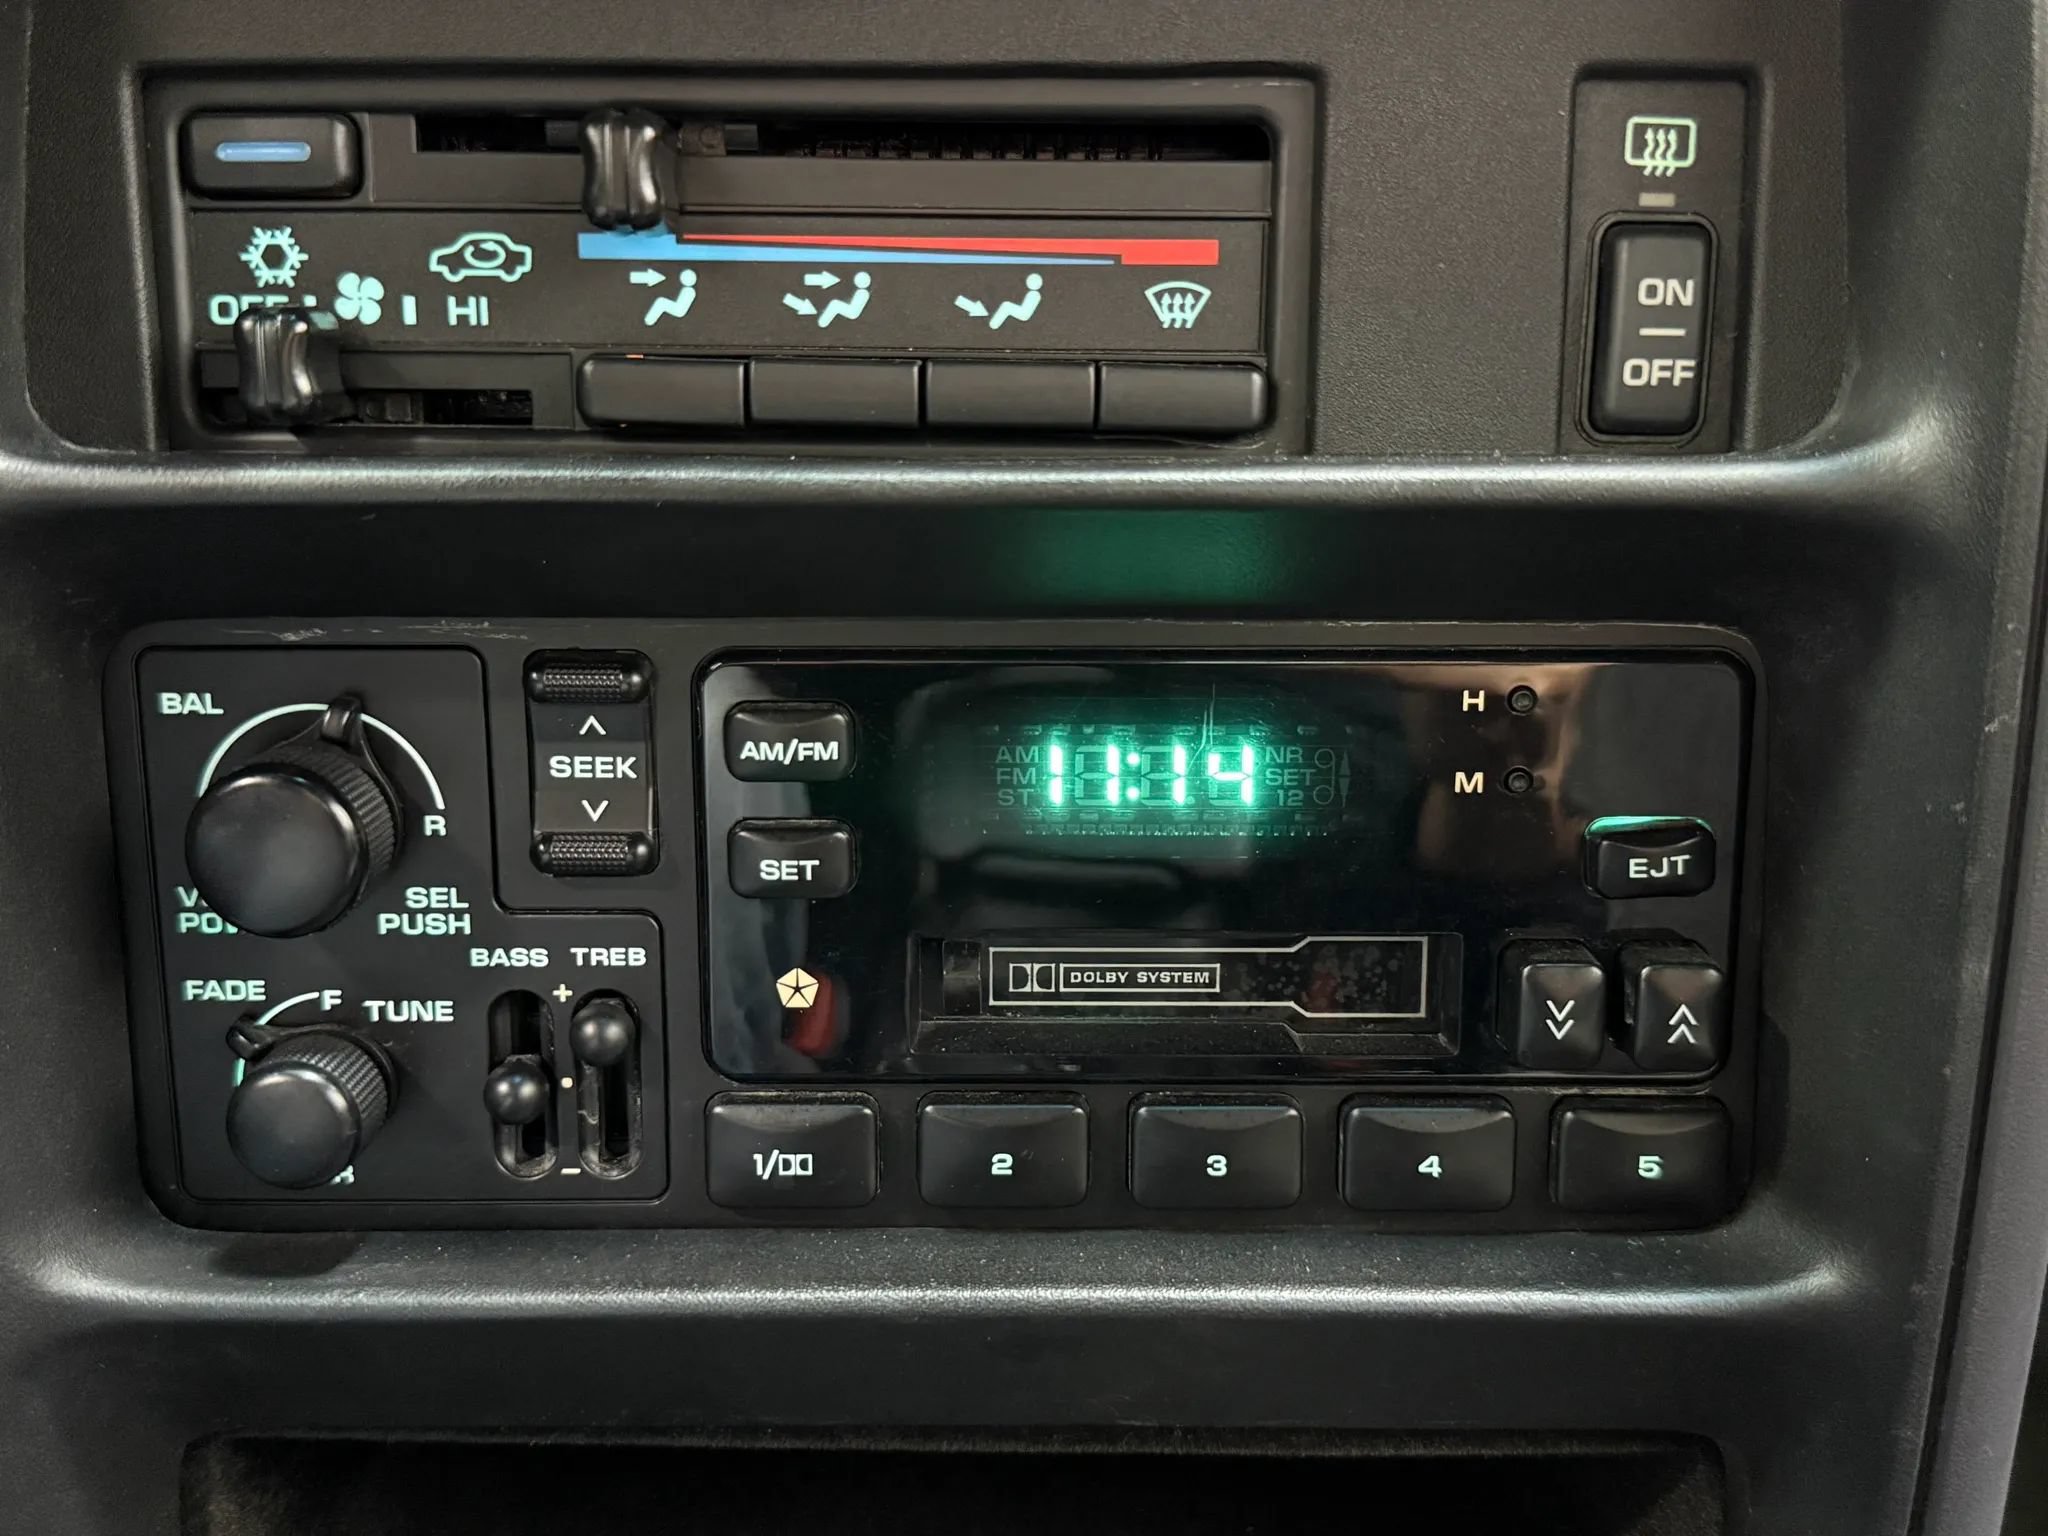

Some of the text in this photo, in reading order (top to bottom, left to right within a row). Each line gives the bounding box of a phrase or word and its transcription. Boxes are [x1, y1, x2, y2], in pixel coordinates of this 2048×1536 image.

[1637, 277, 1695, 306] ON
[447, 295, 489, 326] HI
[1622, 358, 1696, 387] OFF
[159, 692, 224, 715] BAL
[1462, 690, 1485, 712] H
[740, 738, 839, 768] AM/FM
[549, 755, 638, 779] SEEK
[1046, 743, 1256, 807] 11:14
[1454, 771, 1485, 794] M
[423, 814, 447, 837] R
[759, 859, 820, 881] SET
[1628, 854, 1692, 879] EJT
[404, 886, 470, 909] SEL
[377, 912, 472, 936] PUSH
[469, 946, 550, 968] BASS
[569, 946, 648, 968] TREB
[1069, 971, 1210, 984] DOLBY SYSTEM
[183, 978, 266, 1001] FADE
[319, 988, 343, 1011] F
[362, 999, 455, 1022] TUNE
[990, 1153, 1014, 1175] 2
[1205, 1154, 1229, 1177] 3
[1417, 1154, 1444, 1178] 4
[1636, 1155, 1663, 1178] 5
